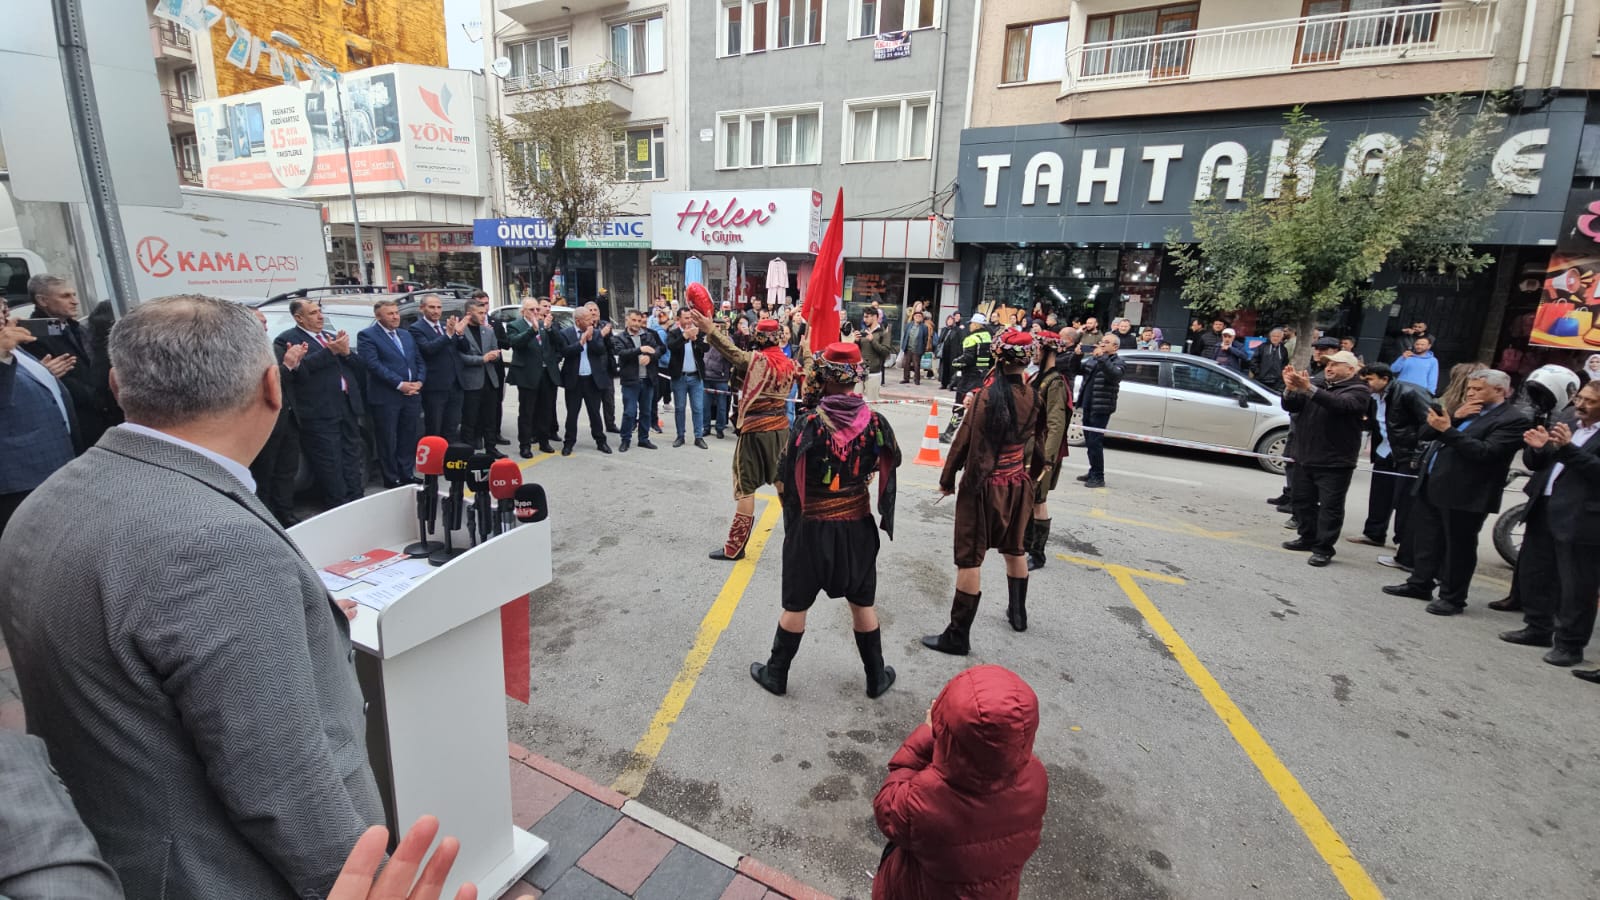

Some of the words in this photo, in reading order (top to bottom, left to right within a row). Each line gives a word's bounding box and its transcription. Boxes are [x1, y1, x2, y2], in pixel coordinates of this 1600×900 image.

[271, 128, 286, 149] 15
[408, 122, 454, 143] YÖN
[677, 197, 770, 235] Helen
[422, 233, 439, 251] 15
[701, 228, 711, 245] İç
[711, 230, 743, 245] Giyim
[177, 251, 253, 272] KAMA
[416, 445, 430, 465] 3
